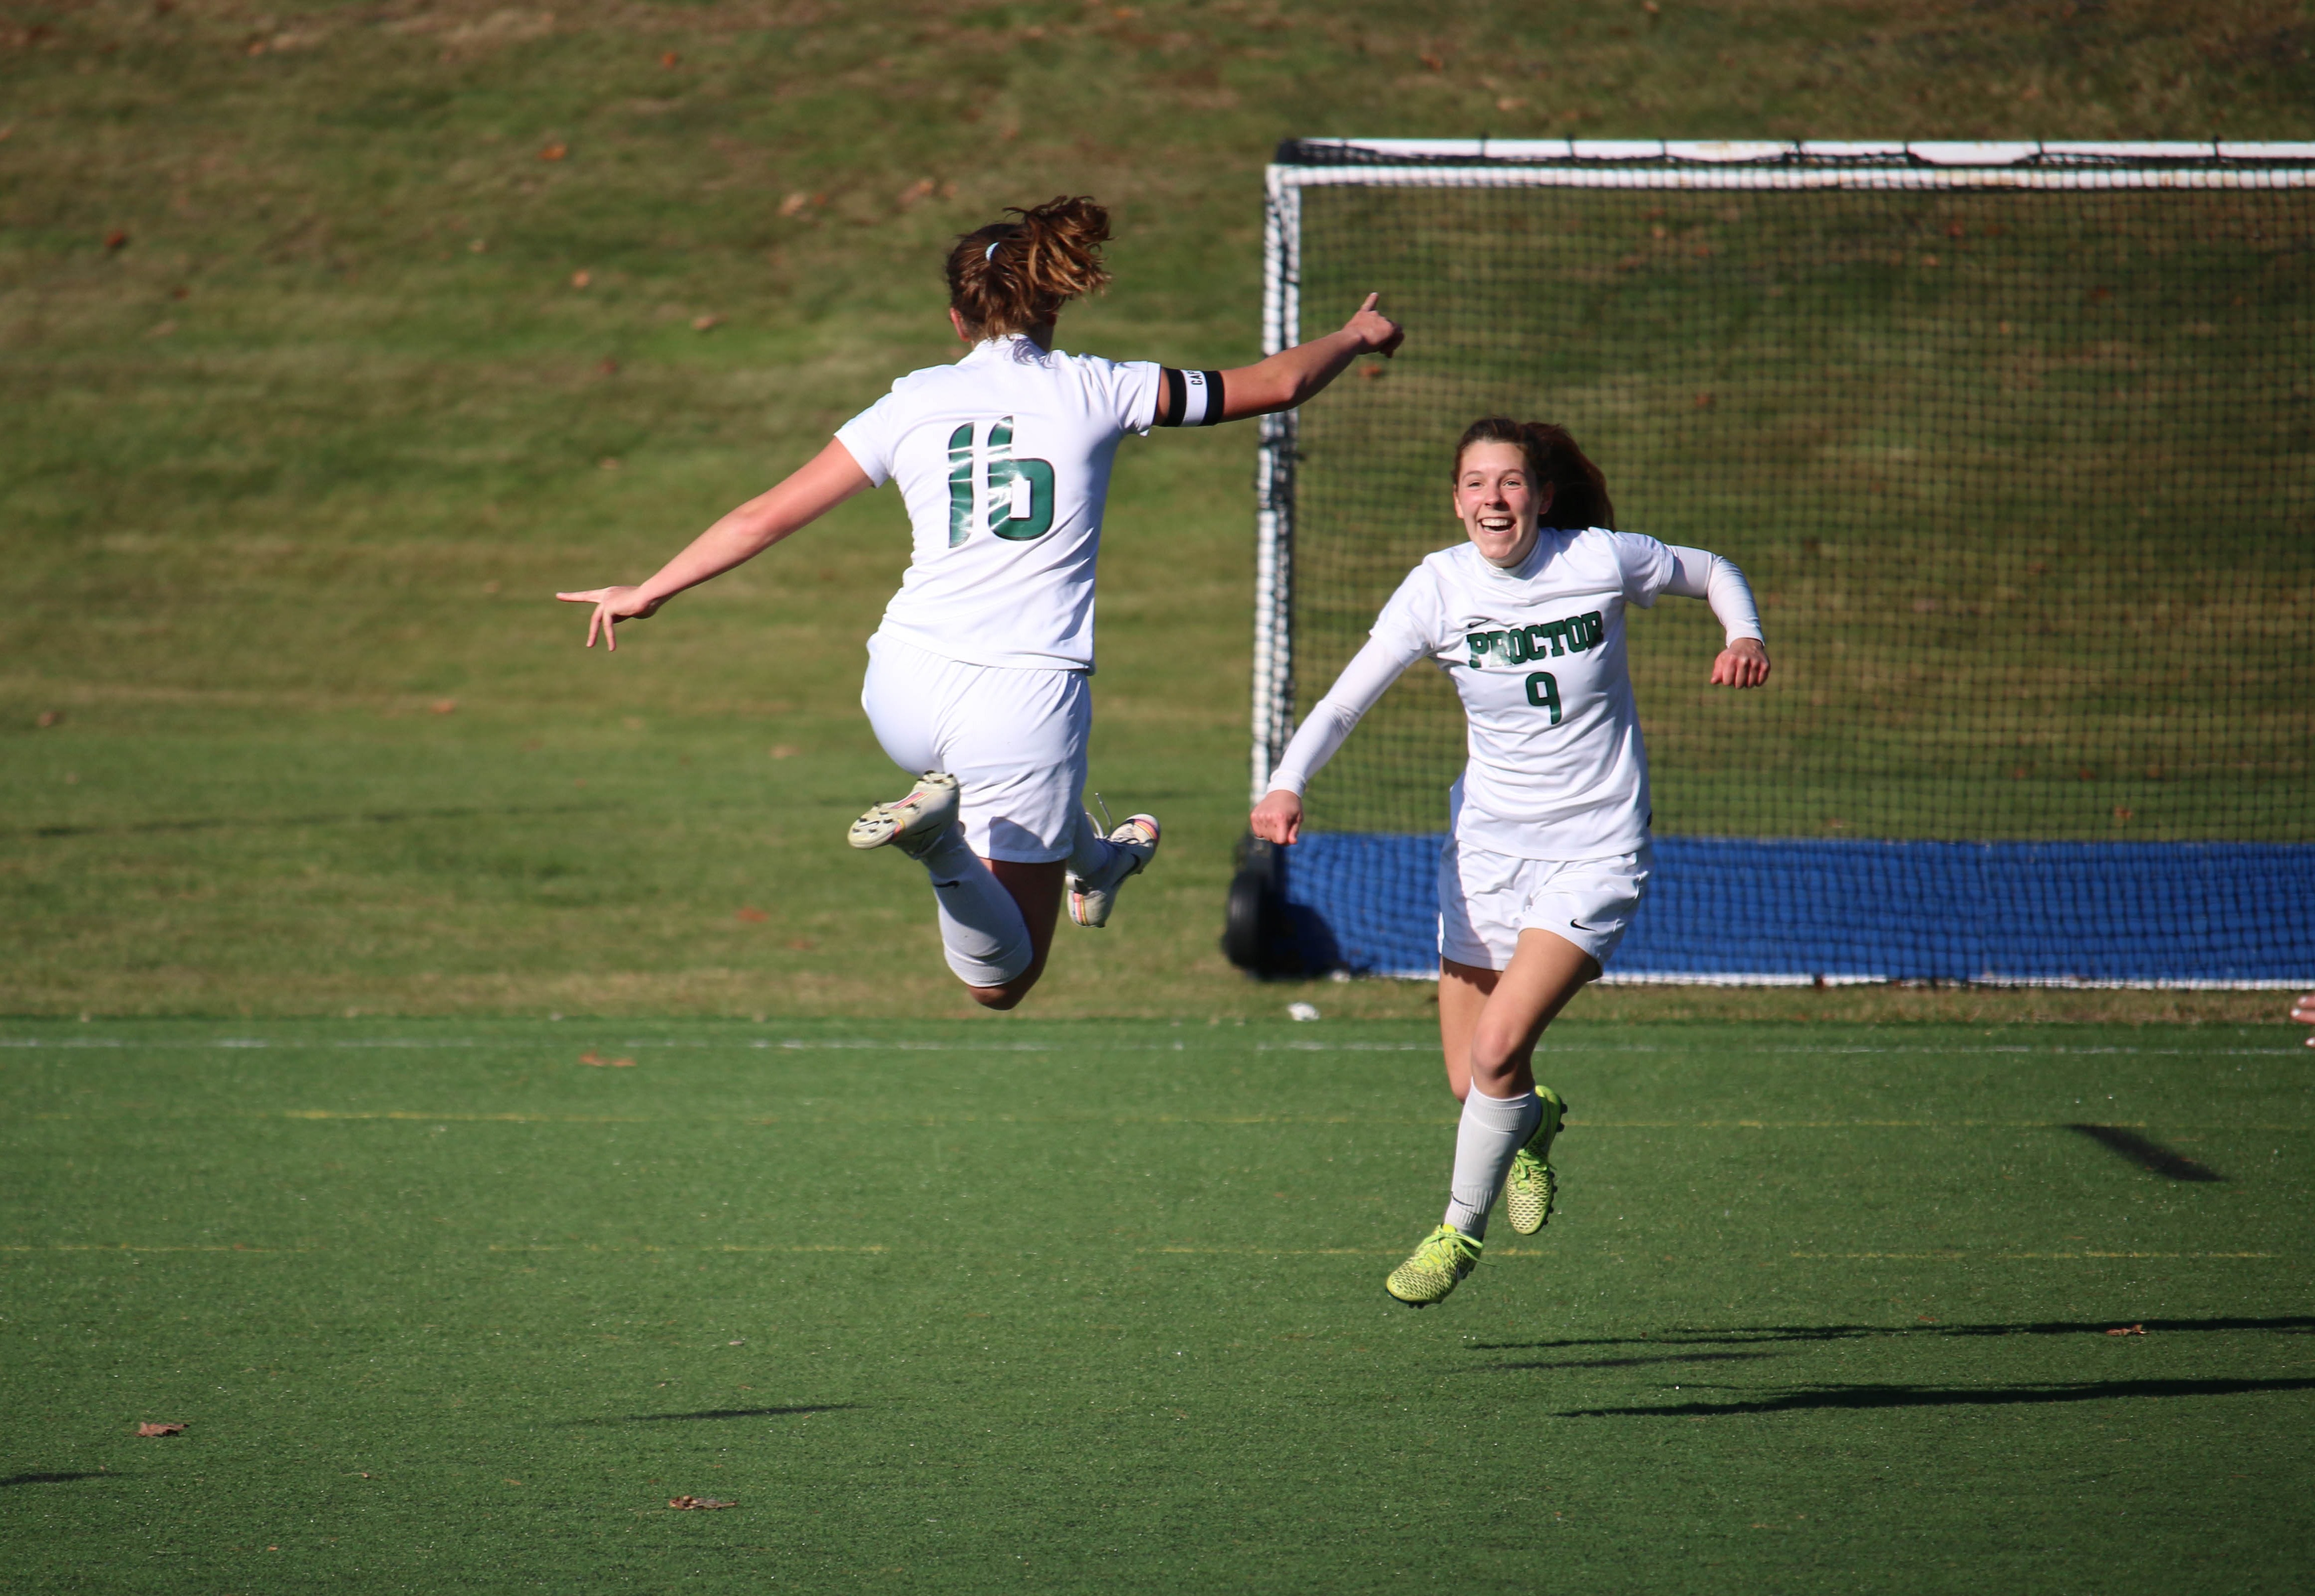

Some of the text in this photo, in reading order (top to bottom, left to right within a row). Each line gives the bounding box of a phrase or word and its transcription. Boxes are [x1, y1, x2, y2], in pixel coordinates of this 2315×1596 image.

[947, 415, 1055, 548] 16
[1467, 611, 1604, 668] PROCTOR
[1525, 671, 1562, 725] 9
